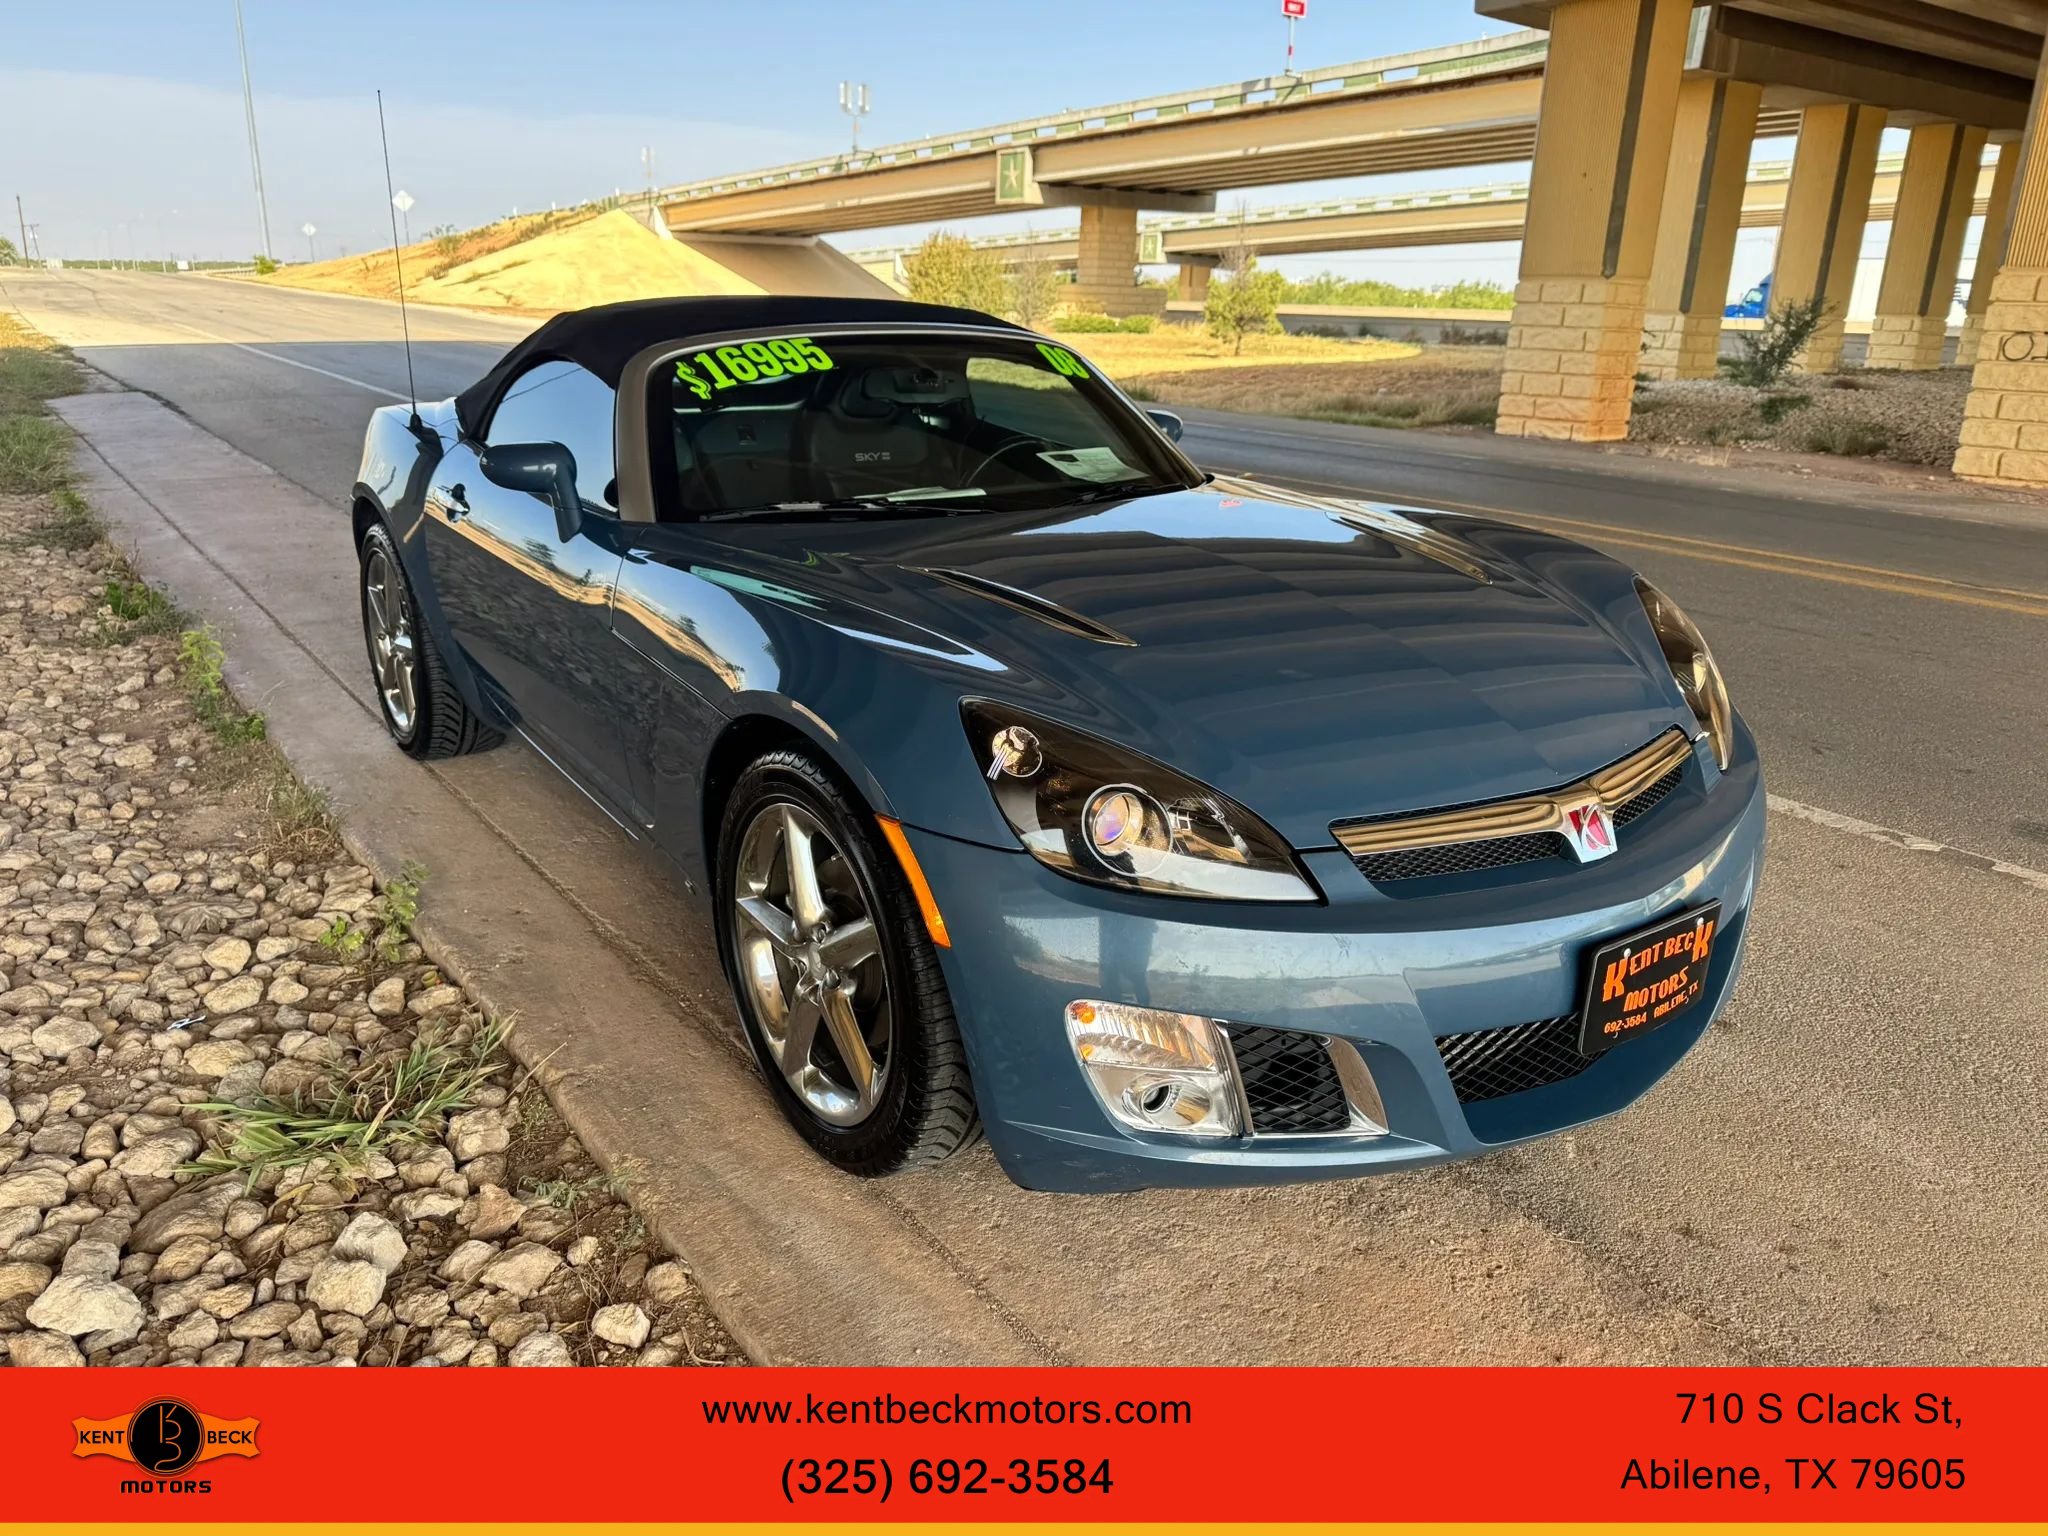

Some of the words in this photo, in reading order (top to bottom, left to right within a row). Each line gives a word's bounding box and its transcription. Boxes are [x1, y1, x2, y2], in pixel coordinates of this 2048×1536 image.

[675, 337, 834, 400] $16995
[1035, 343, 1090, 379] 08
[855, 452, 881, 462] SKY
[1602, 941, 1664, 1002] KENT
[1663, 919, 1715, 964] BECK
[1603, 1011, 1648, 1035] 692-3584
[1688, 979, 1699, 996] TX
[1623, 965, 1689, 1012] MOTORS
